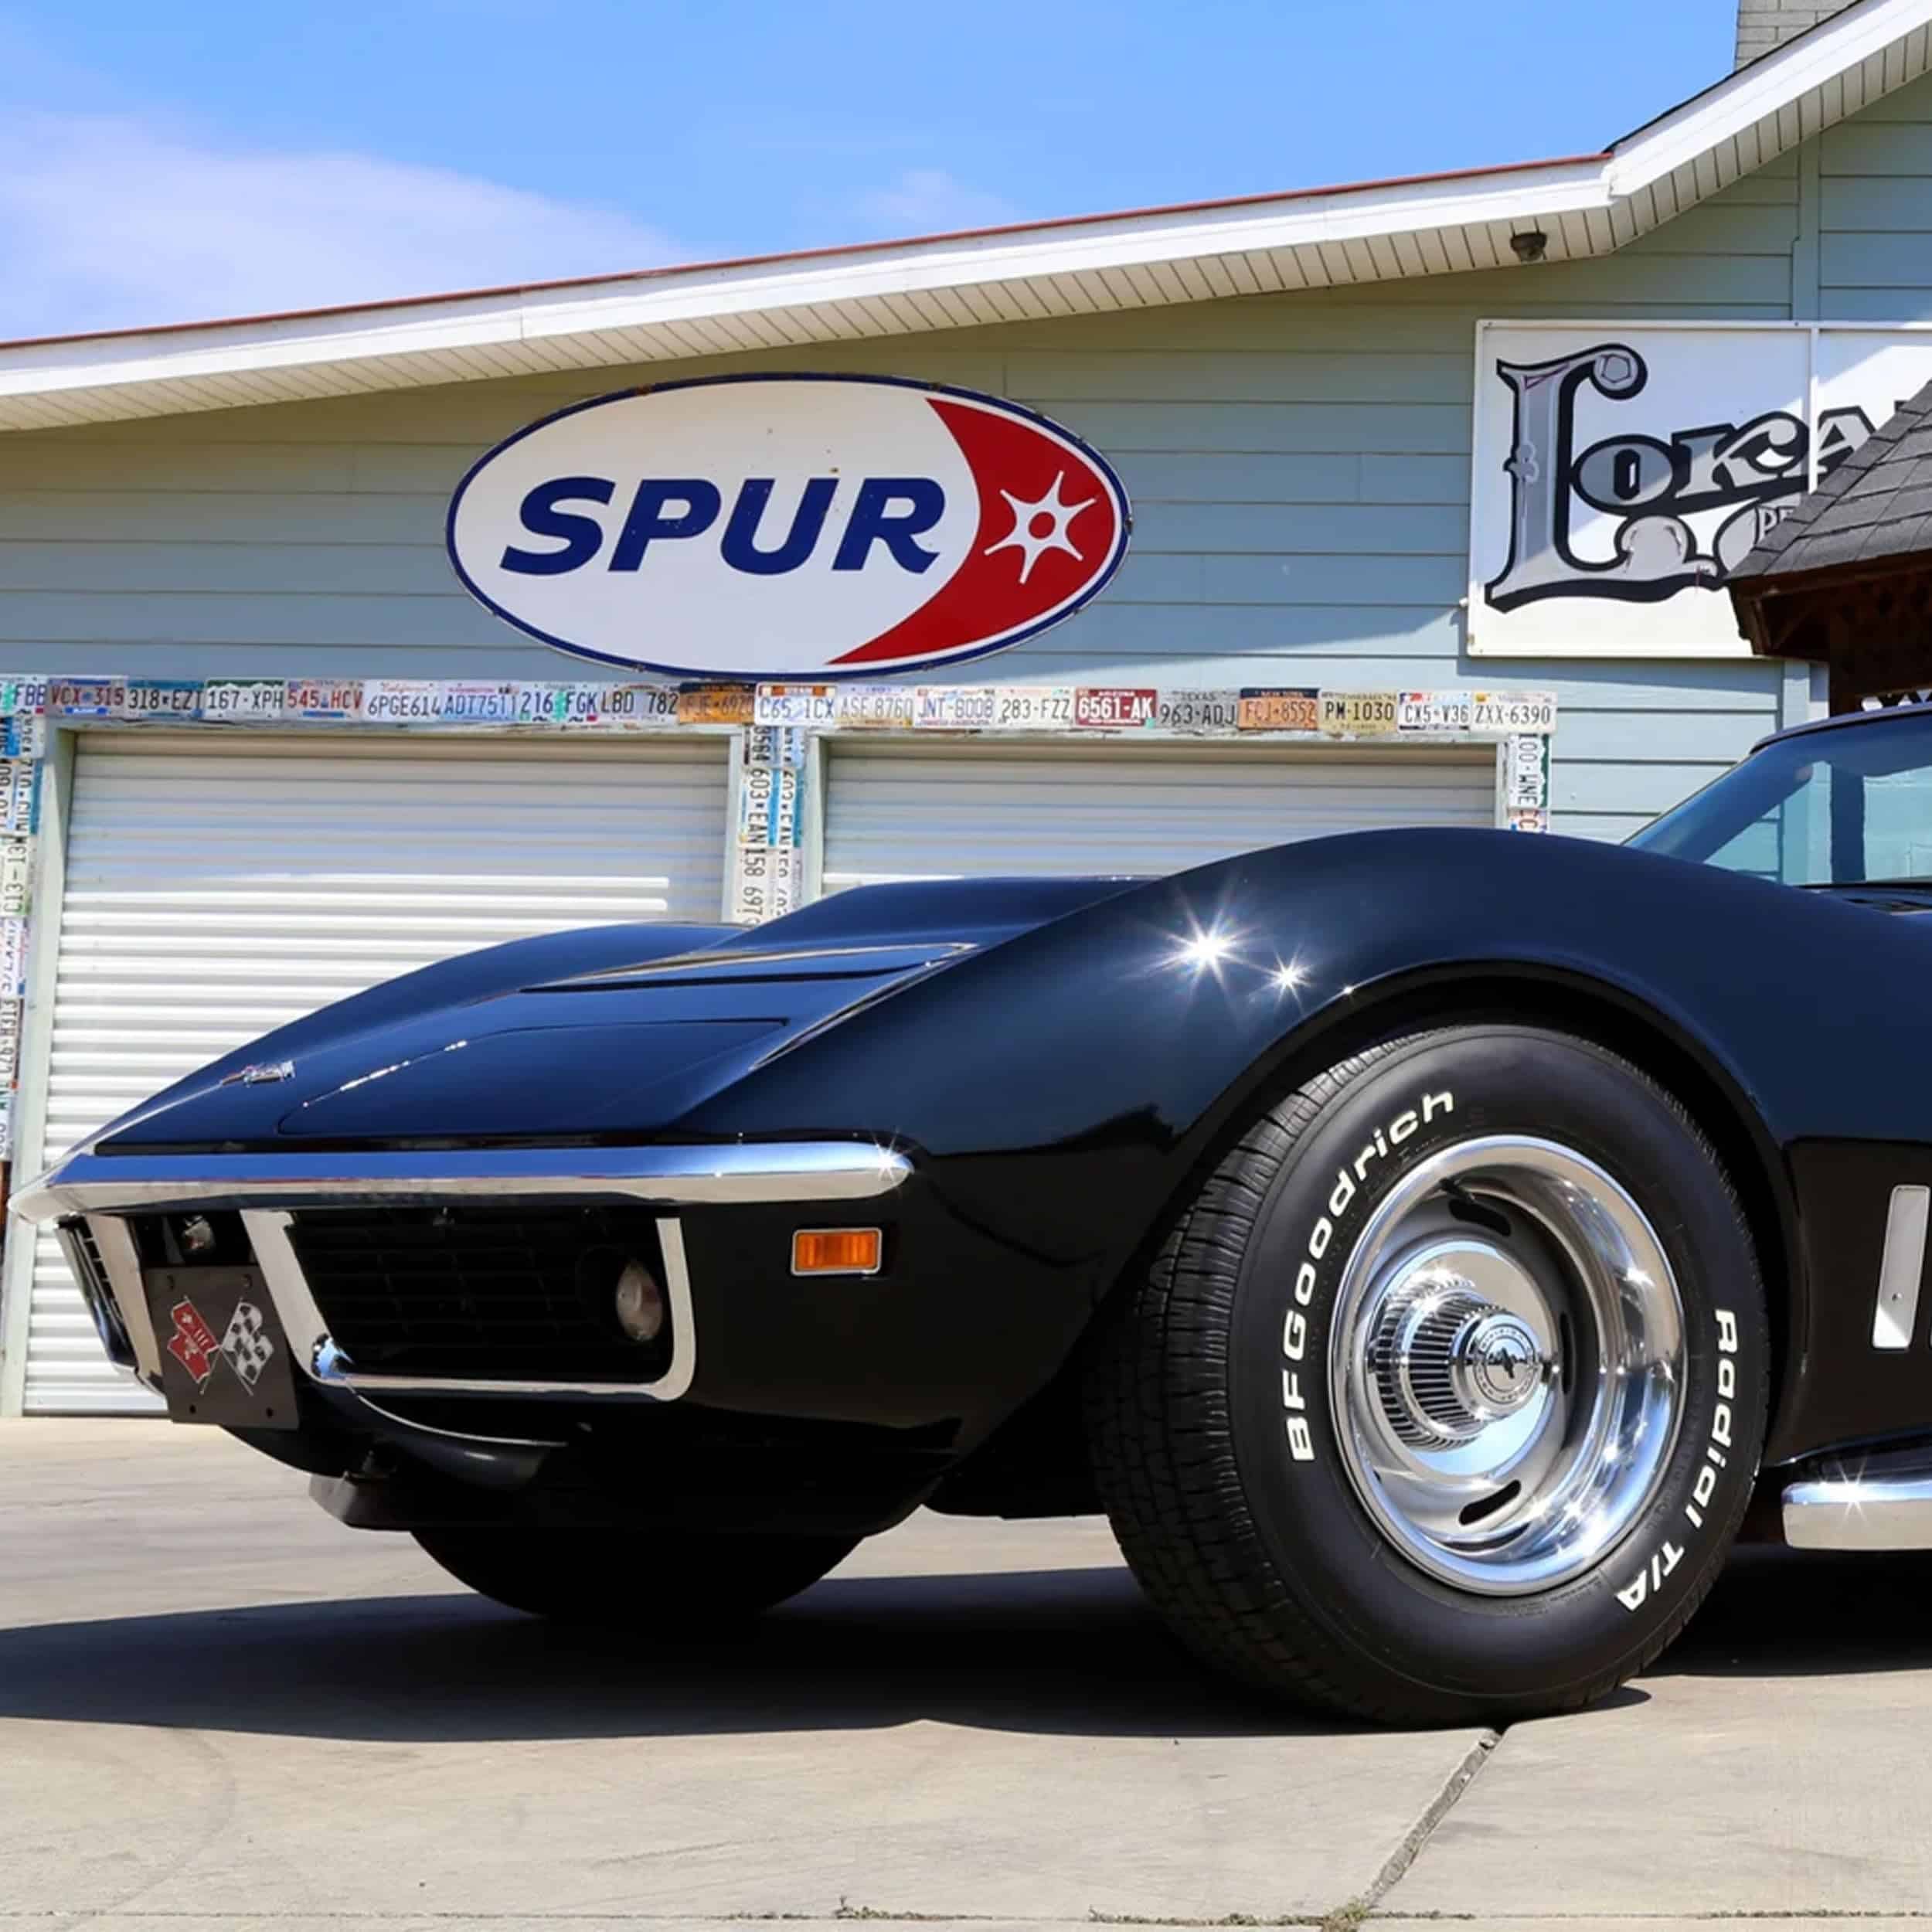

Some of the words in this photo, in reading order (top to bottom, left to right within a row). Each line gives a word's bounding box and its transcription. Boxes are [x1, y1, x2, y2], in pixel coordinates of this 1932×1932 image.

[499, 475, 946, 576] SPUR
[128, 689, 160, 709] 318
[287, 690, 320, 709] 545
[368, 694, 441, 716] 6PGE614
[520, 691, 553, 713] 216
[648, 691, 679, 715] 782
[1078, 696, 1153, 718] 6561-AK
[1282, 1089, 1454, 1461] BFGoodrich
[1685, 1309, 1739, 1529] Radial
[1616, 1541, 1685, 1612] T/A
